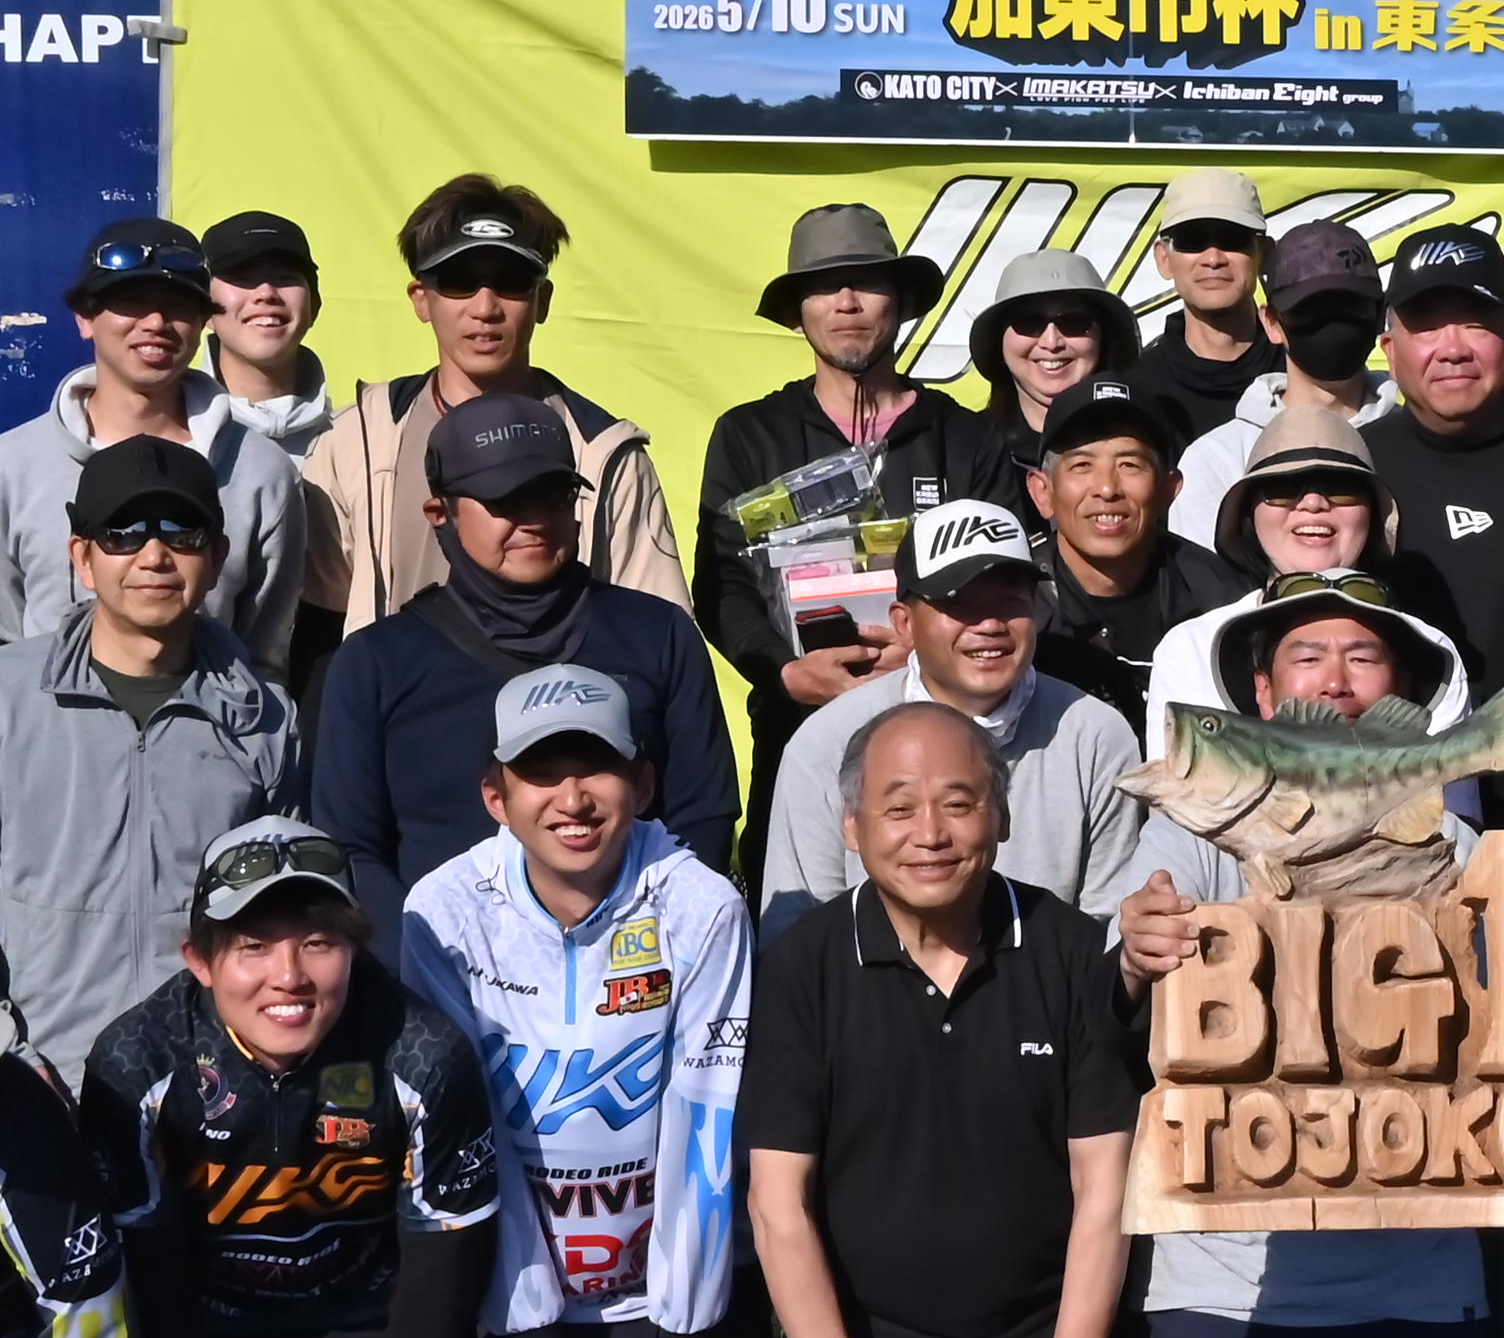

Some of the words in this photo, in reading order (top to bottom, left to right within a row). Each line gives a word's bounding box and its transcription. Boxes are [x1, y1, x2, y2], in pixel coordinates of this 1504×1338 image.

[654, 3, 714, 31] 2026
[833, 2, 906, 34] SUN
[1314, 7, 1363, 51] in
[884, 74, 942, 99] KATO
[946, 75, 996, 101] CITY
[1023, 77, 1156, 99] IMAKATSU
[1183, 81, 1270, 101] Ichiban
[1273, 82, 1340, 106] Eight
[1342, 92, 1384, 105] group
[1163, 900, 1460, 1081] BIG
[1020, 1042, 1054, 1056] FILA
[597, 1157, 649, 1179] RIDE
